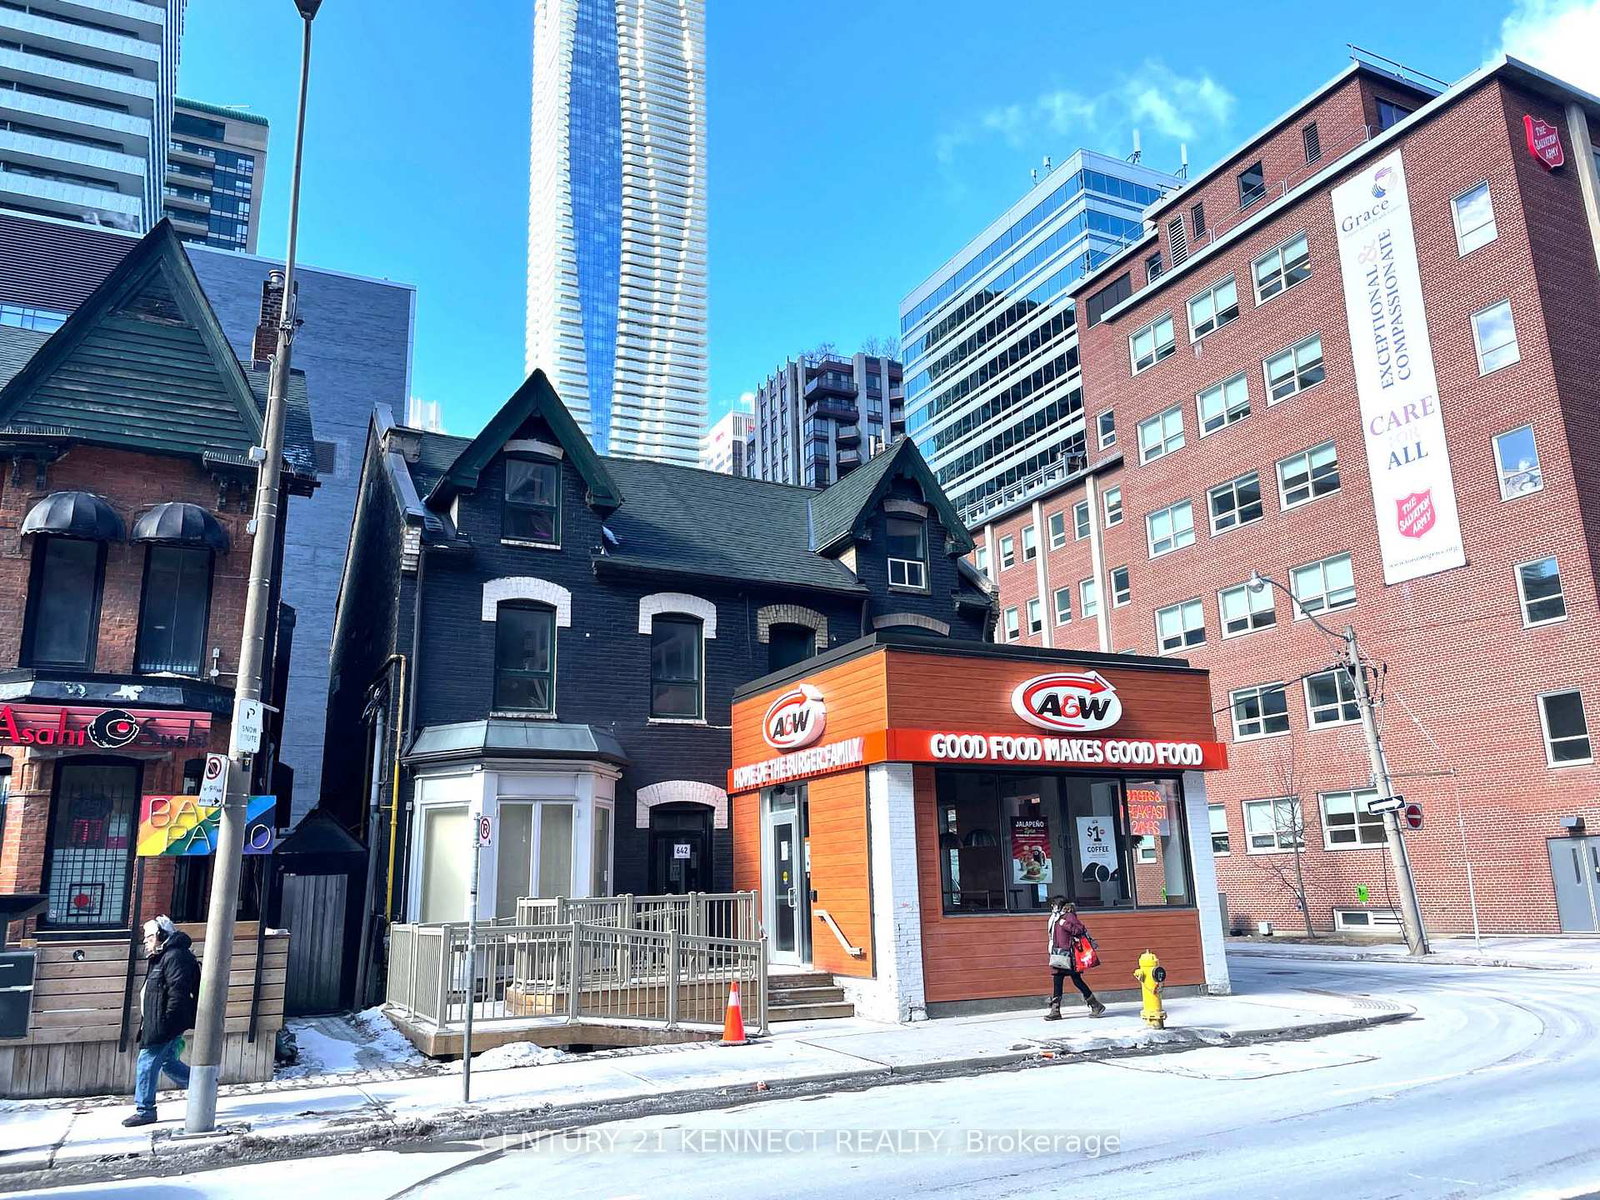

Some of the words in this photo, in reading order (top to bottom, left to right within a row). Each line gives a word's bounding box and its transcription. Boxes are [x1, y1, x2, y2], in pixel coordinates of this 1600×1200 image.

[1341, 200, 1389, 232] Grace
[1378, 228, 1411, 381] COMPASSIONATE
[1366, 264, 1394, 389] EXCEPTIONAL
[1370, 395, 1435, 436] CARE
[1387, 441, 1429, 470] ALL
[1402, 496, 1417, 515] THE
[1412, 508, 1431, 535] ARMY
[1036, 692, 1111, 721] A&W
[0, 705, 86, 747] Asahi
[241, 725, 257, 734] SNOW
[772, 708, 810, 739] A&W
[929, 733, 988, 760] GOOD
[989, 736, 1042, 761] FOOD
[1043, 738, 1104, 763] MAKES
[1105, 741, 1156, 764] GOOD
[1156, 743, 1204, 765] FOOD
[163, 824, 271, 851] PAO
[1015, 819, 1045, 828] JALAPEÑO
[676, 846, 688, 855] 642
[1086, 845, 1110, 853] COFFEE
